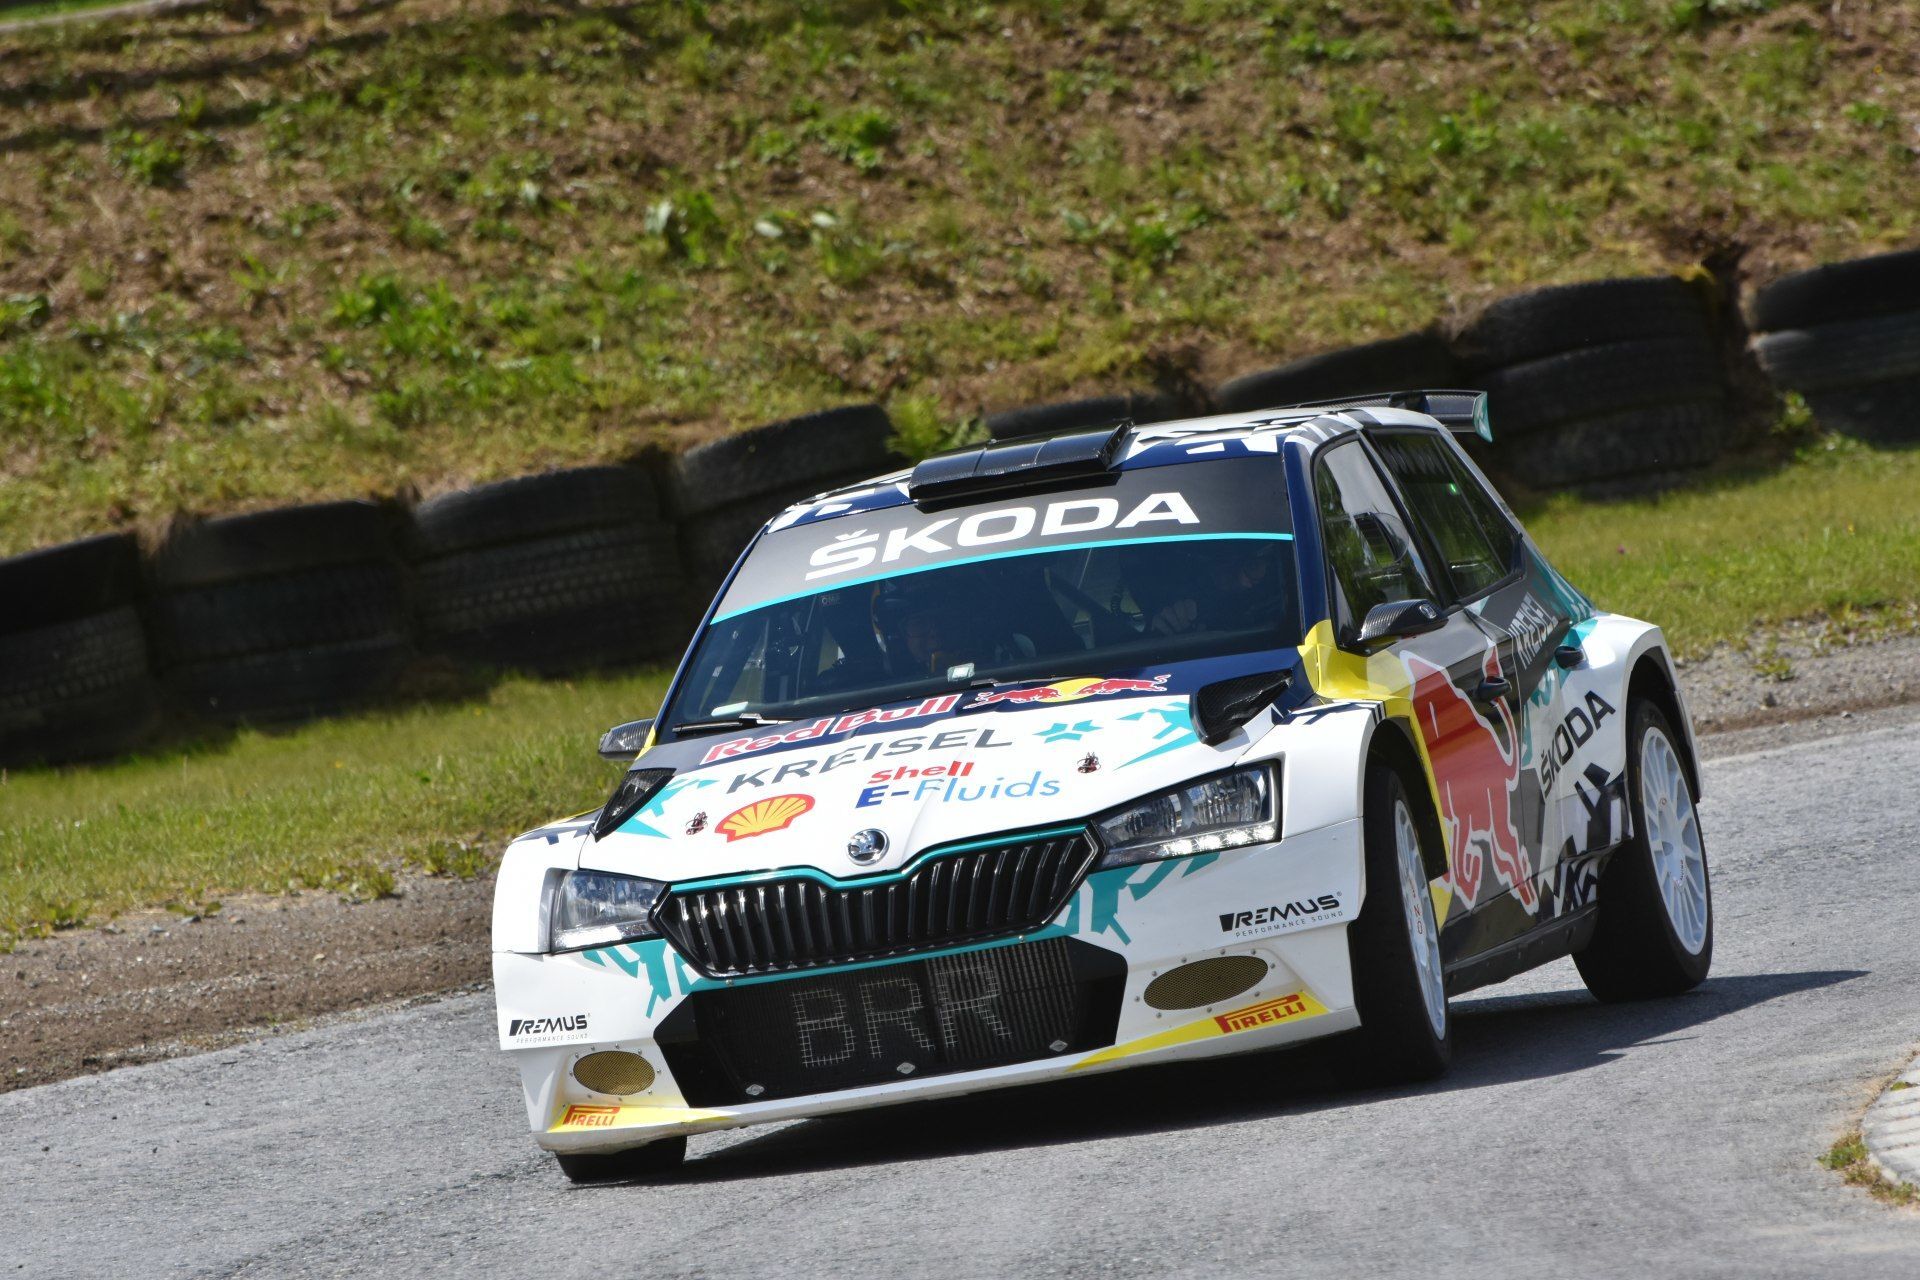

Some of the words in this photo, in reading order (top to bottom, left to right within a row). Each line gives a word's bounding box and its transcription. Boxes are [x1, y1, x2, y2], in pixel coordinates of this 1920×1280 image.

[805, 492, 1200, 581] ŠKODA
[1508, 591, 1559, 670] KREISEL
[700, 697, 837, 766] Red
[829, 693, 963, 735] Bull
[726, 728, 1013, 795] KREISEL
[1541, 690, 1617, 799] ŠKODA
[855, 770, 1061, 809] E-Fluids
[867, 760, 975, 784] Shell
[1235, 918, 1306, 938] PERFORMANCE
[1311, 910, 1344, 922] SOUND
[792, 965, 1013, 1068] BRR
[1213, 993, 1307, 1034] PIRELLI
[562, 1105, 621, 1126] PIRELLI
